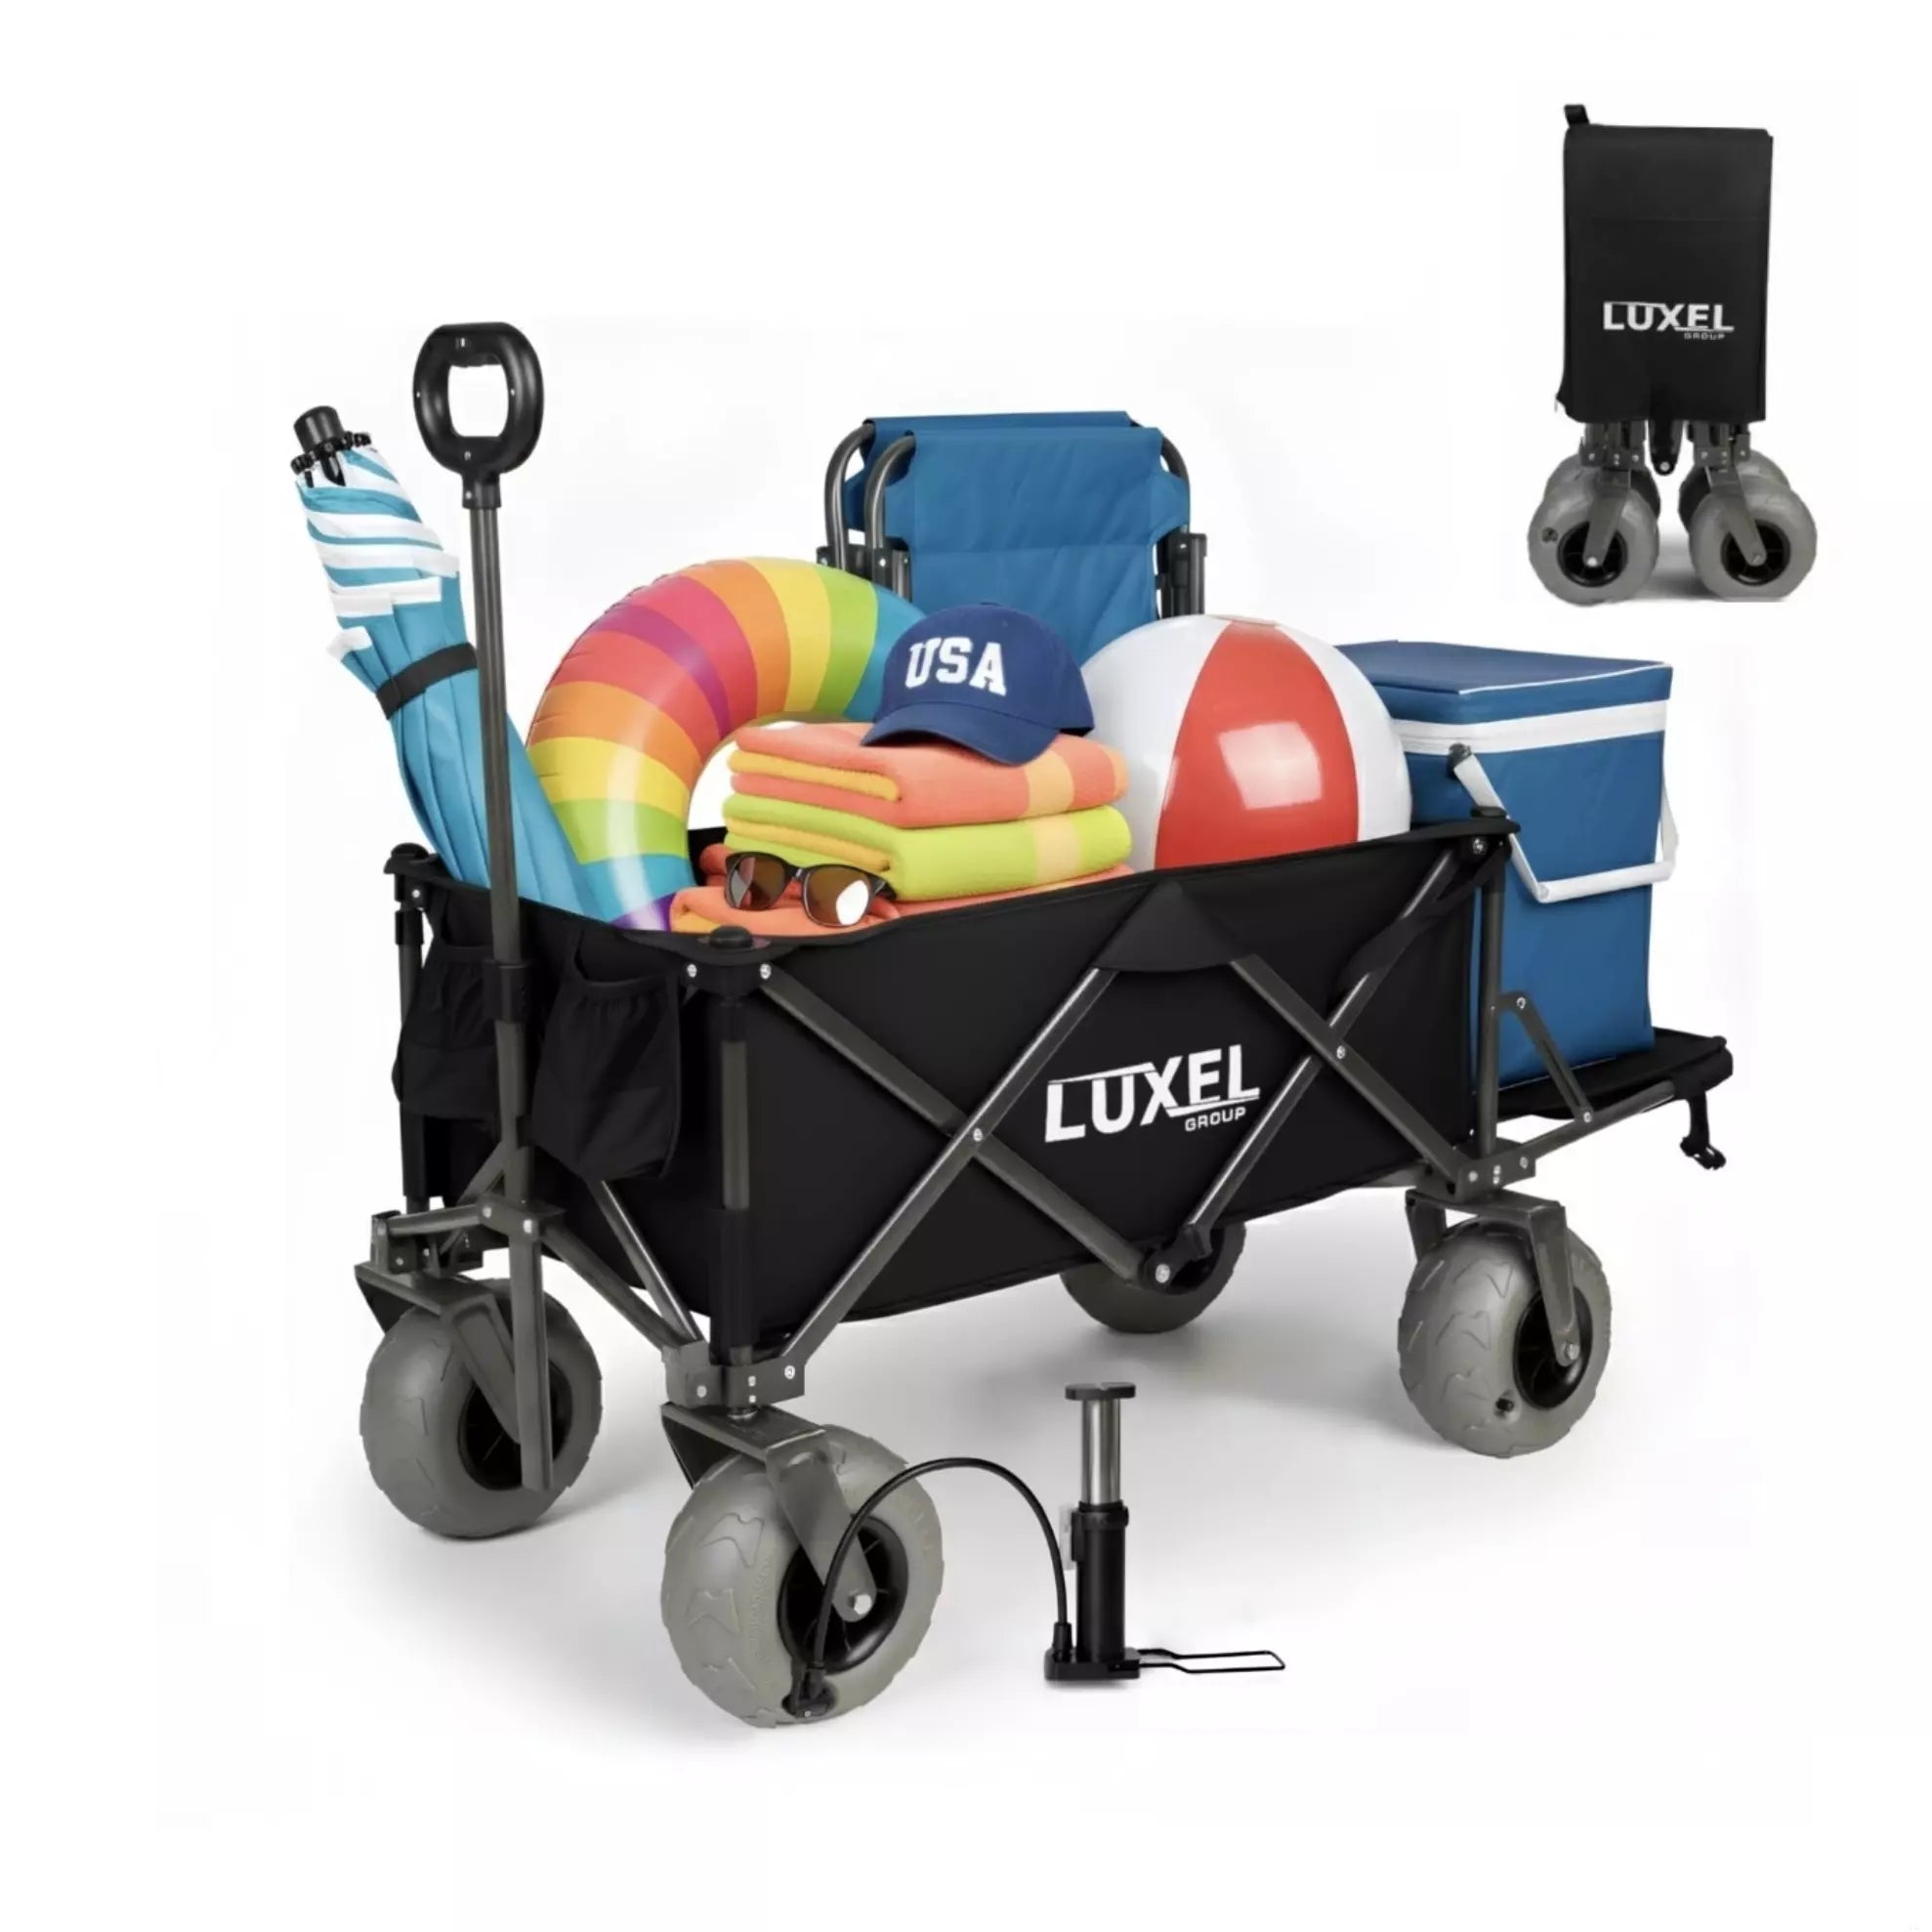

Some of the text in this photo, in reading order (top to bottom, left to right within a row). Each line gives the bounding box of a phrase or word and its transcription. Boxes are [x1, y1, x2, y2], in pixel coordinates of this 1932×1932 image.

[1603, 301, 1735, 332] LUXEL
[1683, 331, 1726, 341] GROUP
[905, 636, 1007, 696] USA
[1044, 1044, 1260, 1143] LUXEL
[1185, 1107, 1246, 1132] GROUP
